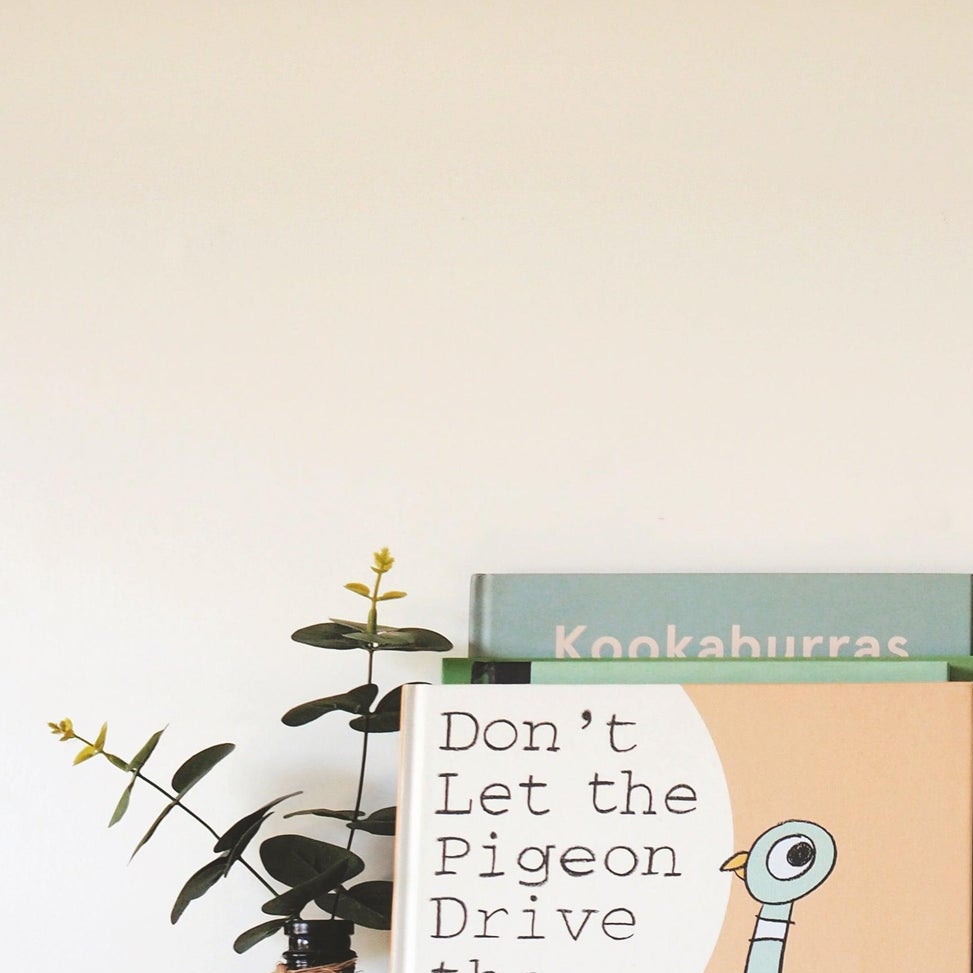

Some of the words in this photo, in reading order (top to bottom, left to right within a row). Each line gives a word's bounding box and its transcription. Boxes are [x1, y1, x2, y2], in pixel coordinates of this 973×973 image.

[555, 624, 909, 658] Kookaburras
[438, 709, 637, 752] Don't
[434, 772, 551, 815] Let
[588, 770, 698, 815] the
[434, 831, 683, 886] Pigeon
[430, 895, 636, 940] Drive
